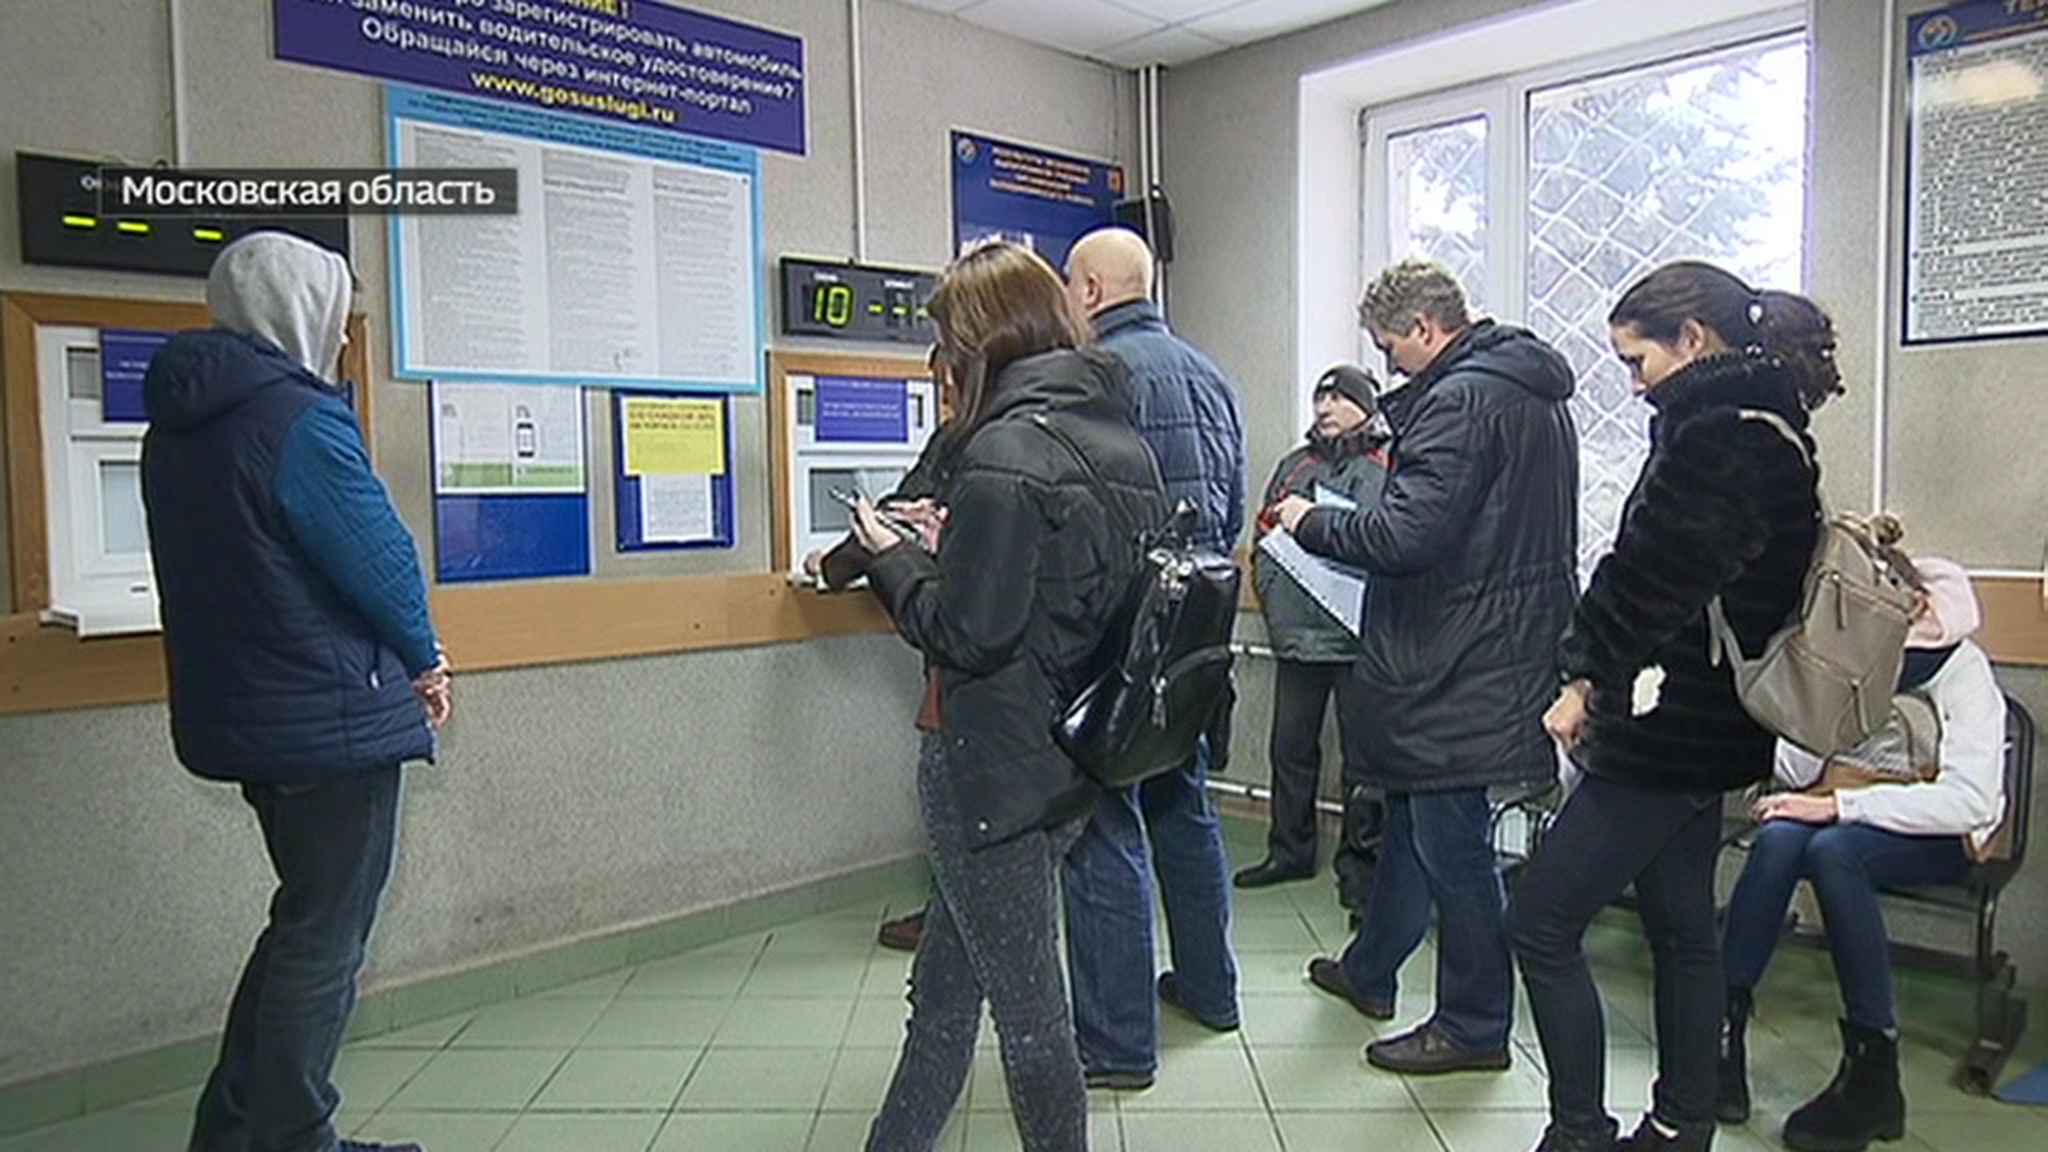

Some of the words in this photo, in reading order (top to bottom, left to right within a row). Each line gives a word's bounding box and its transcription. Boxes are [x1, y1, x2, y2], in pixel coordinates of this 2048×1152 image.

[362, 17, 509, 66] Обращайся
[513, 54, 578, 79] через
[584, 66, 752, 114] интернет-портал
[479, 18, 636, 67] водительское
[640, 54, 794, 98] удостоверение?
[492, 0, 687, 52] зарегистрировать
[691, 43, 802, 79] автомобиль
[471, 72, 676, 123] www.gosuslugi.ru
[815, 286, 851, 326] 10
